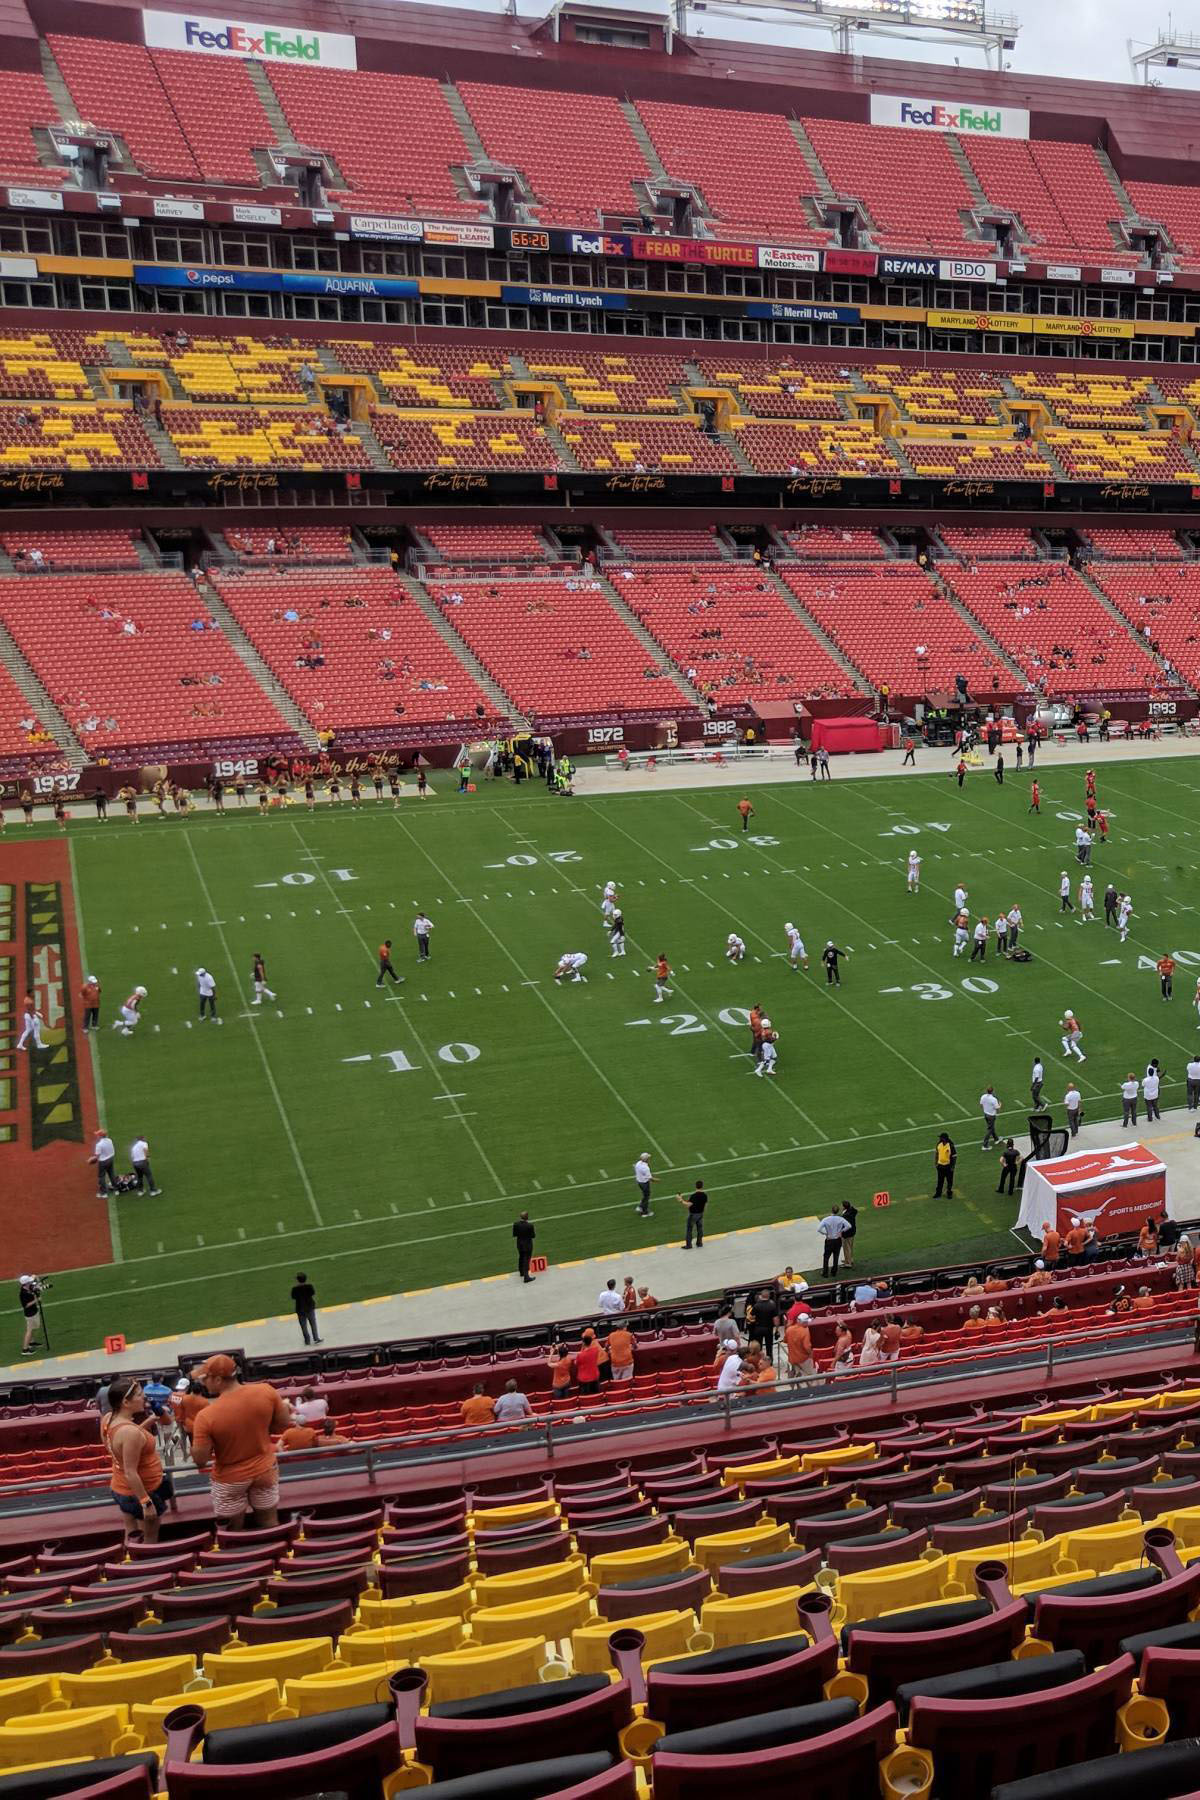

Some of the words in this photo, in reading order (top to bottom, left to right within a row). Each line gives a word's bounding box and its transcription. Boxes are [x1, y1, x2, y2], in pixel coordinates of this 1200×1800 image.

[184, 21, 320, 60] FedExField
[901, 102, 1001, 132] FedExField
[95, 140, 108, 148] 452
[354, 217, 409, 231] Carpetland
[459, 234, 490, 242] LEARN
[572, 235, 623, 255] FedEx
[771, 249, 815, 262] Eastern
[884, 259, 936, 275] RE/MAX
[954, 264, 986, 277] BDO
[202, 272, 234, 285] pepsi
[325, 278, 375, 293] AQUAFINA
[542, 291, 573, 304] Merrill
[575, 294, 602, 306] Lynch
[784, 307, 812, 318] Merrill
[813, 309, 838, 320] Lynch
[940, 316, 977, 328] MARYLAND
[990, 319, 1019, 329] LOTTERY
[1045, 322, 1080, 332] MARYLAND
[1093, 325, 1122, 334] LOTTERY
[587, 727, 624, 743] 1972
[702, 720, 737, 736] 1982
[214, 759, 259, 778] 1942
[33, 773, 81, 794] 1937
[910, 976, 1000, 1001] 30
[660, 1007, 753, 1036] 20
[379, 1042, 481, 1072] 10
[876, 1193, 889, 1207] 20
[1108, 1205, 1133, 1217] SPORTS
[1133, 1200, 1163, 1213] MEDICINE
[531, 1257, 545, 1272] 10
[1115, 1297, 1130, 1311] 28
[110, 1338, 122, 1352] G
